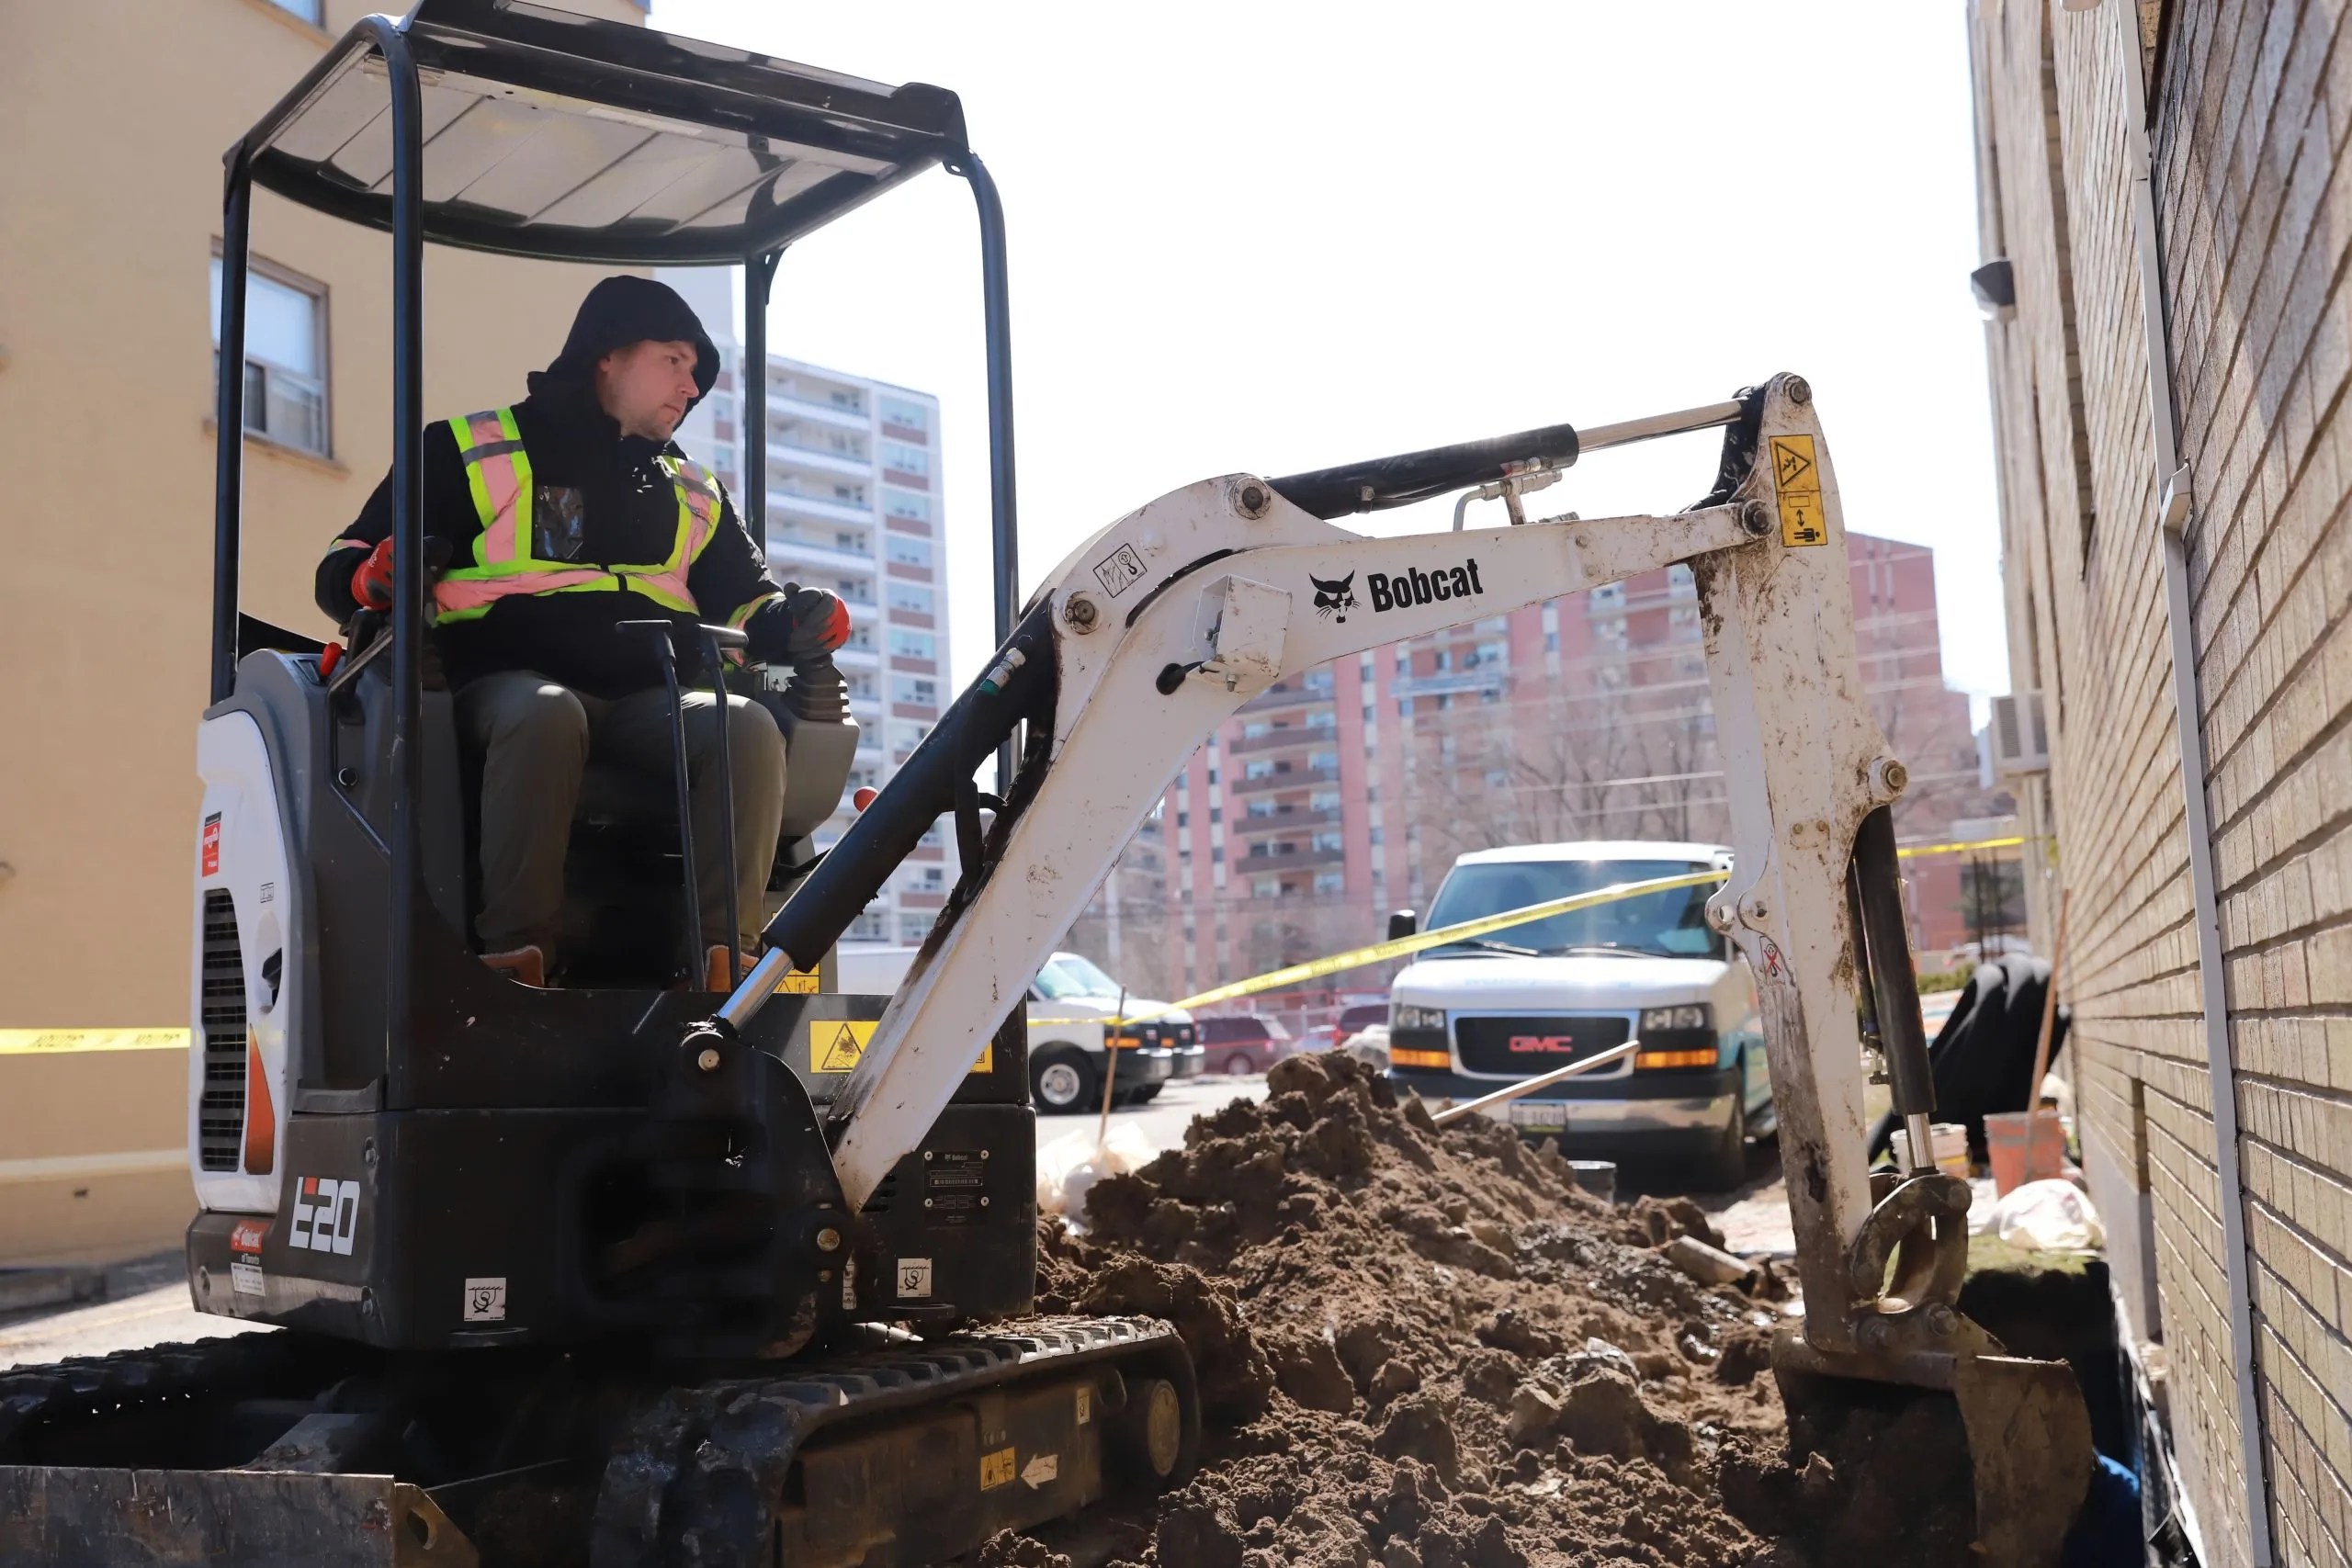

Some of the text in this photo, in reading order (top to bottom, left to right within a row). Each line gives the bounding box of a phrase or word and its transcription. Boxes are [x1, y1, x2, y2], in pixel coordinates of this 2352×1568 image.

[1367, 558, 1483, 613] Bobcat
[1510, 1036, 1573, 1053] GMC
[289, 1177, 360, 1256] E20
